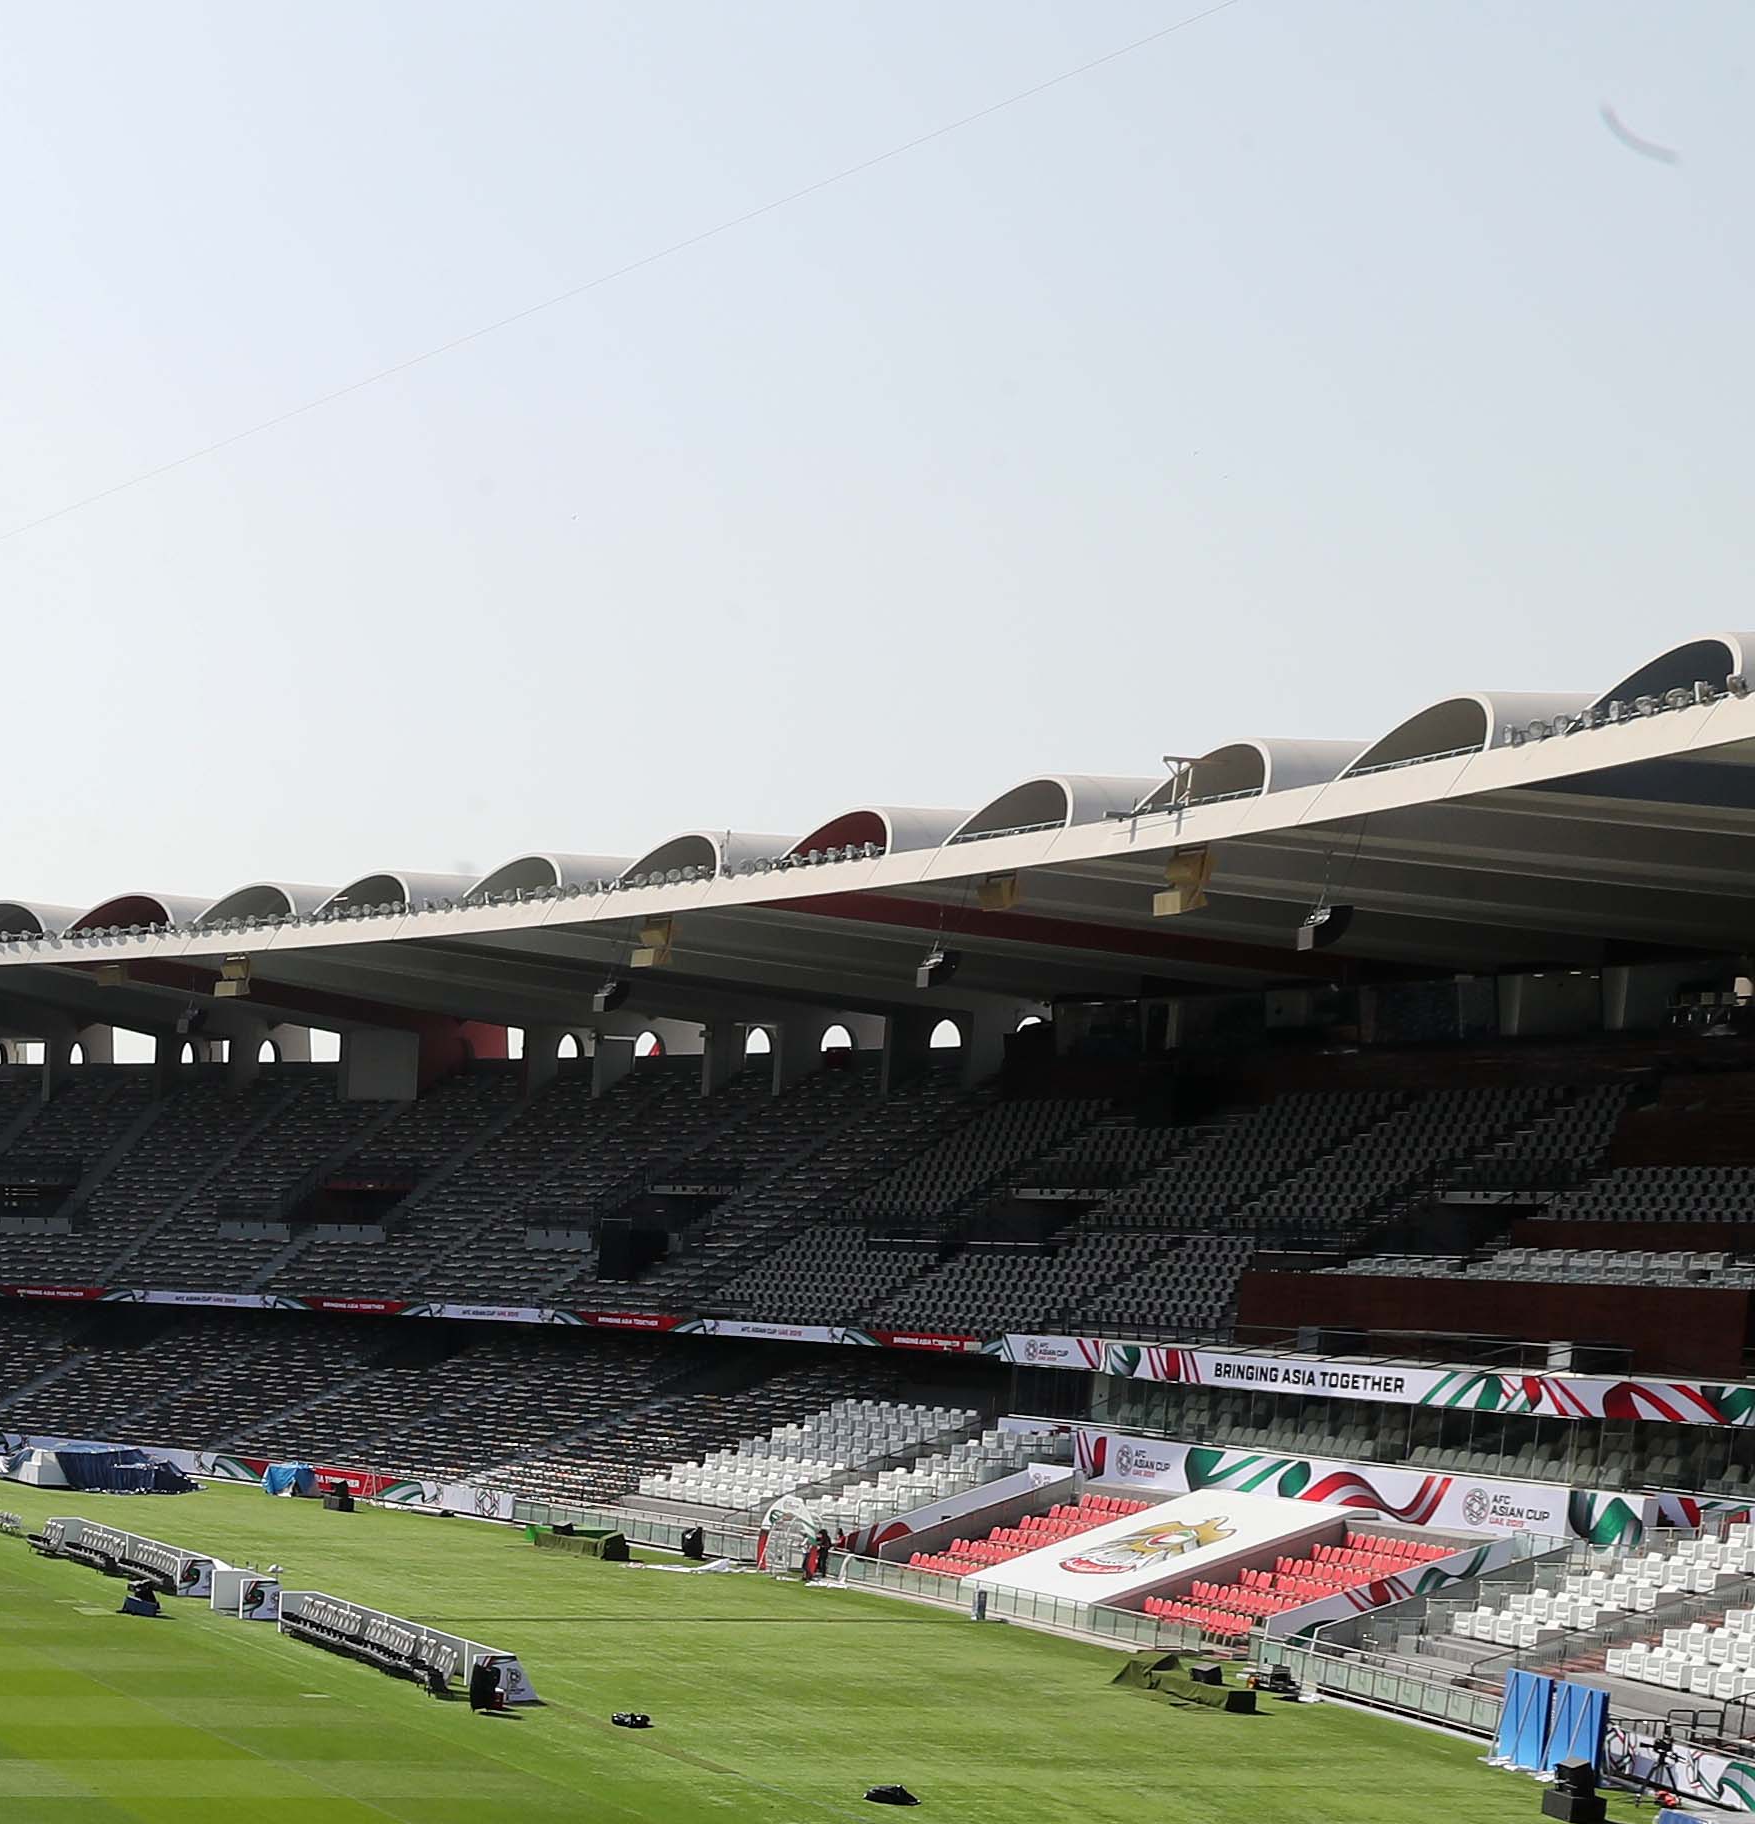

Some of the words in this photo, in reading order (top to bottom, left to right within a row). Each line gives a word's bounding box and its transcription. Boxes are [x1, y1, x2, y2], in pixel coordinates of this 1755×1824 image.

[1214, 1362, 1278, 1382] BRINGING
[1282, 1369, 1315, 1386] ASIA
[1320, 1372, 1405, 1393] TOGETHER
[1492, 1494, 1511, 1504] AFC
[1491, 1506, 1523, 1518] ASIAN
[1526, 1508, 1551, 1521] CUP
[1489, 1517, 1504, 1526] UAE
